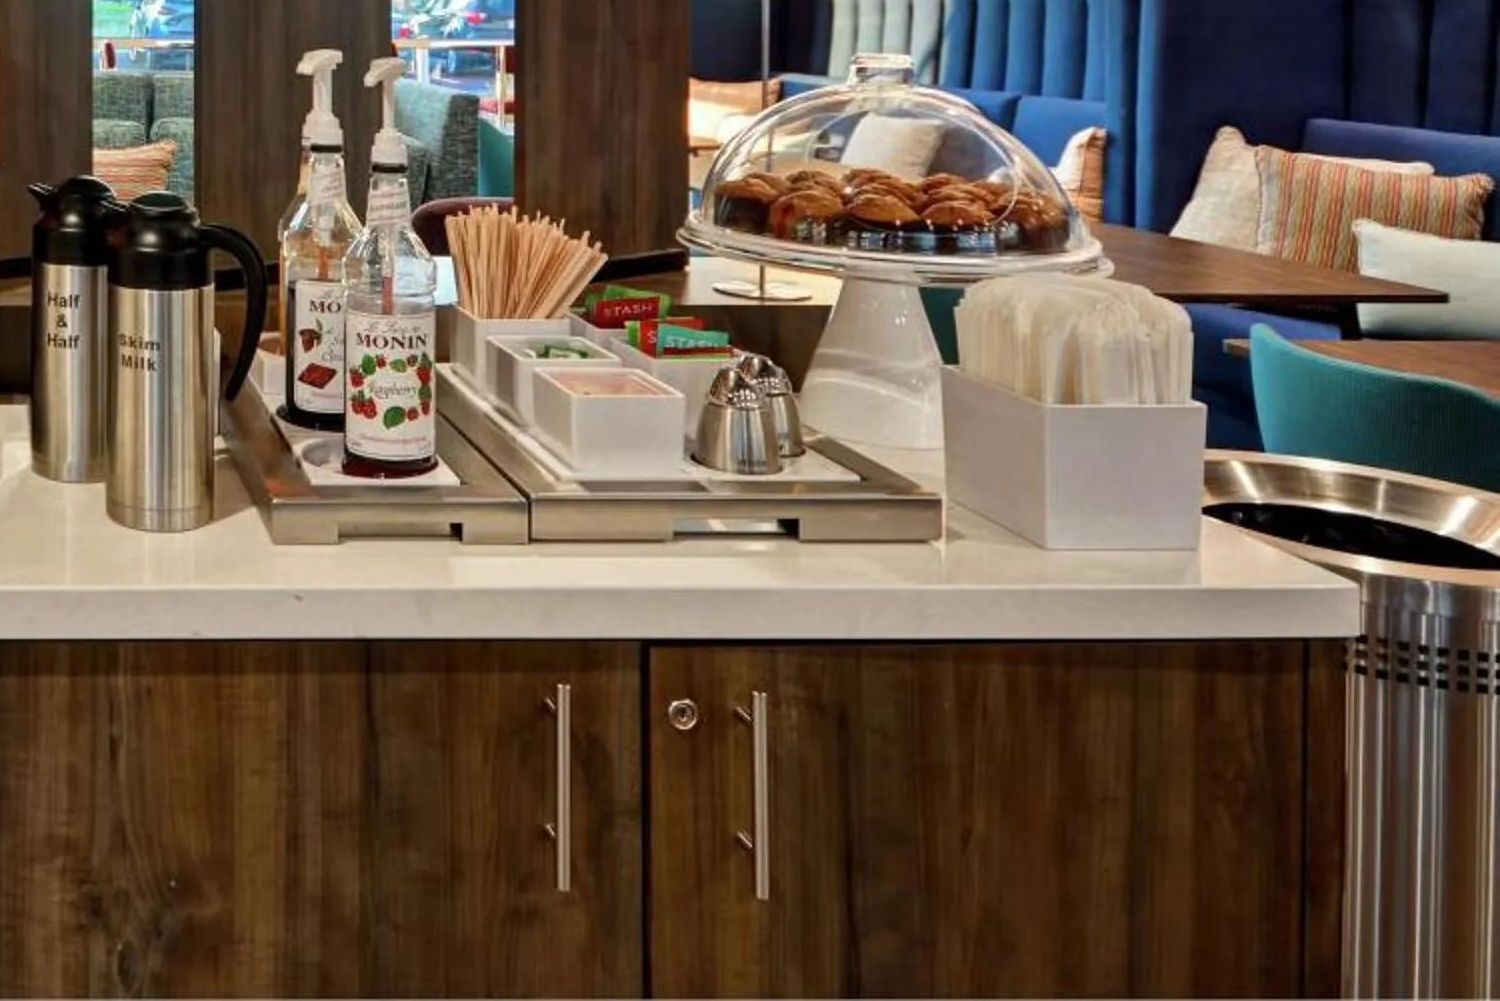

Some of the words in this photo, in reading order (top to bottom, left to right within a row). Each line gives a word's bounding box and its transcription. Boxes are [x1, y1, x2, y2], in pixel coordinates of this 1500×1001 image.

[47, 292, 81, 309] Half
[56, 314, 68, 329] &
[47, 332, 81, 349] Half
[119, 333, 161, 350] Skim
[356, 332, 428, 349] MONIN
[121, 354, 158, 372] Milk
